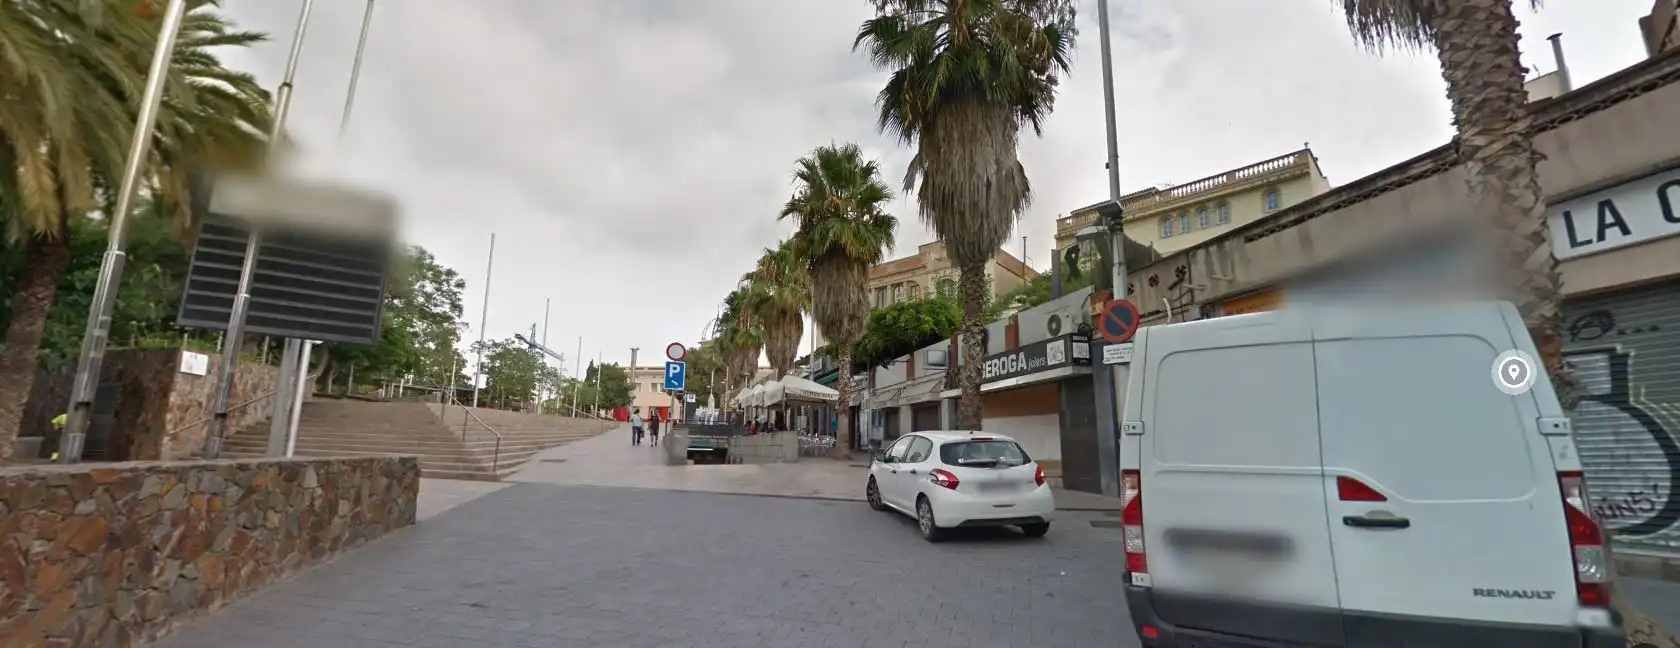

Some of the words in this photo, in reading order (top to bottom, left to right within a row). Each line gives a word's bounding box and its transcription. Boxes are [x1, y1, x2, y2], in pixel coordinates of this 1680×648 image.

[1562, 198, 1632, 249] LA
[669, 363, 681, 378] P
[1472, 588, 1556, 600] RENAULT
